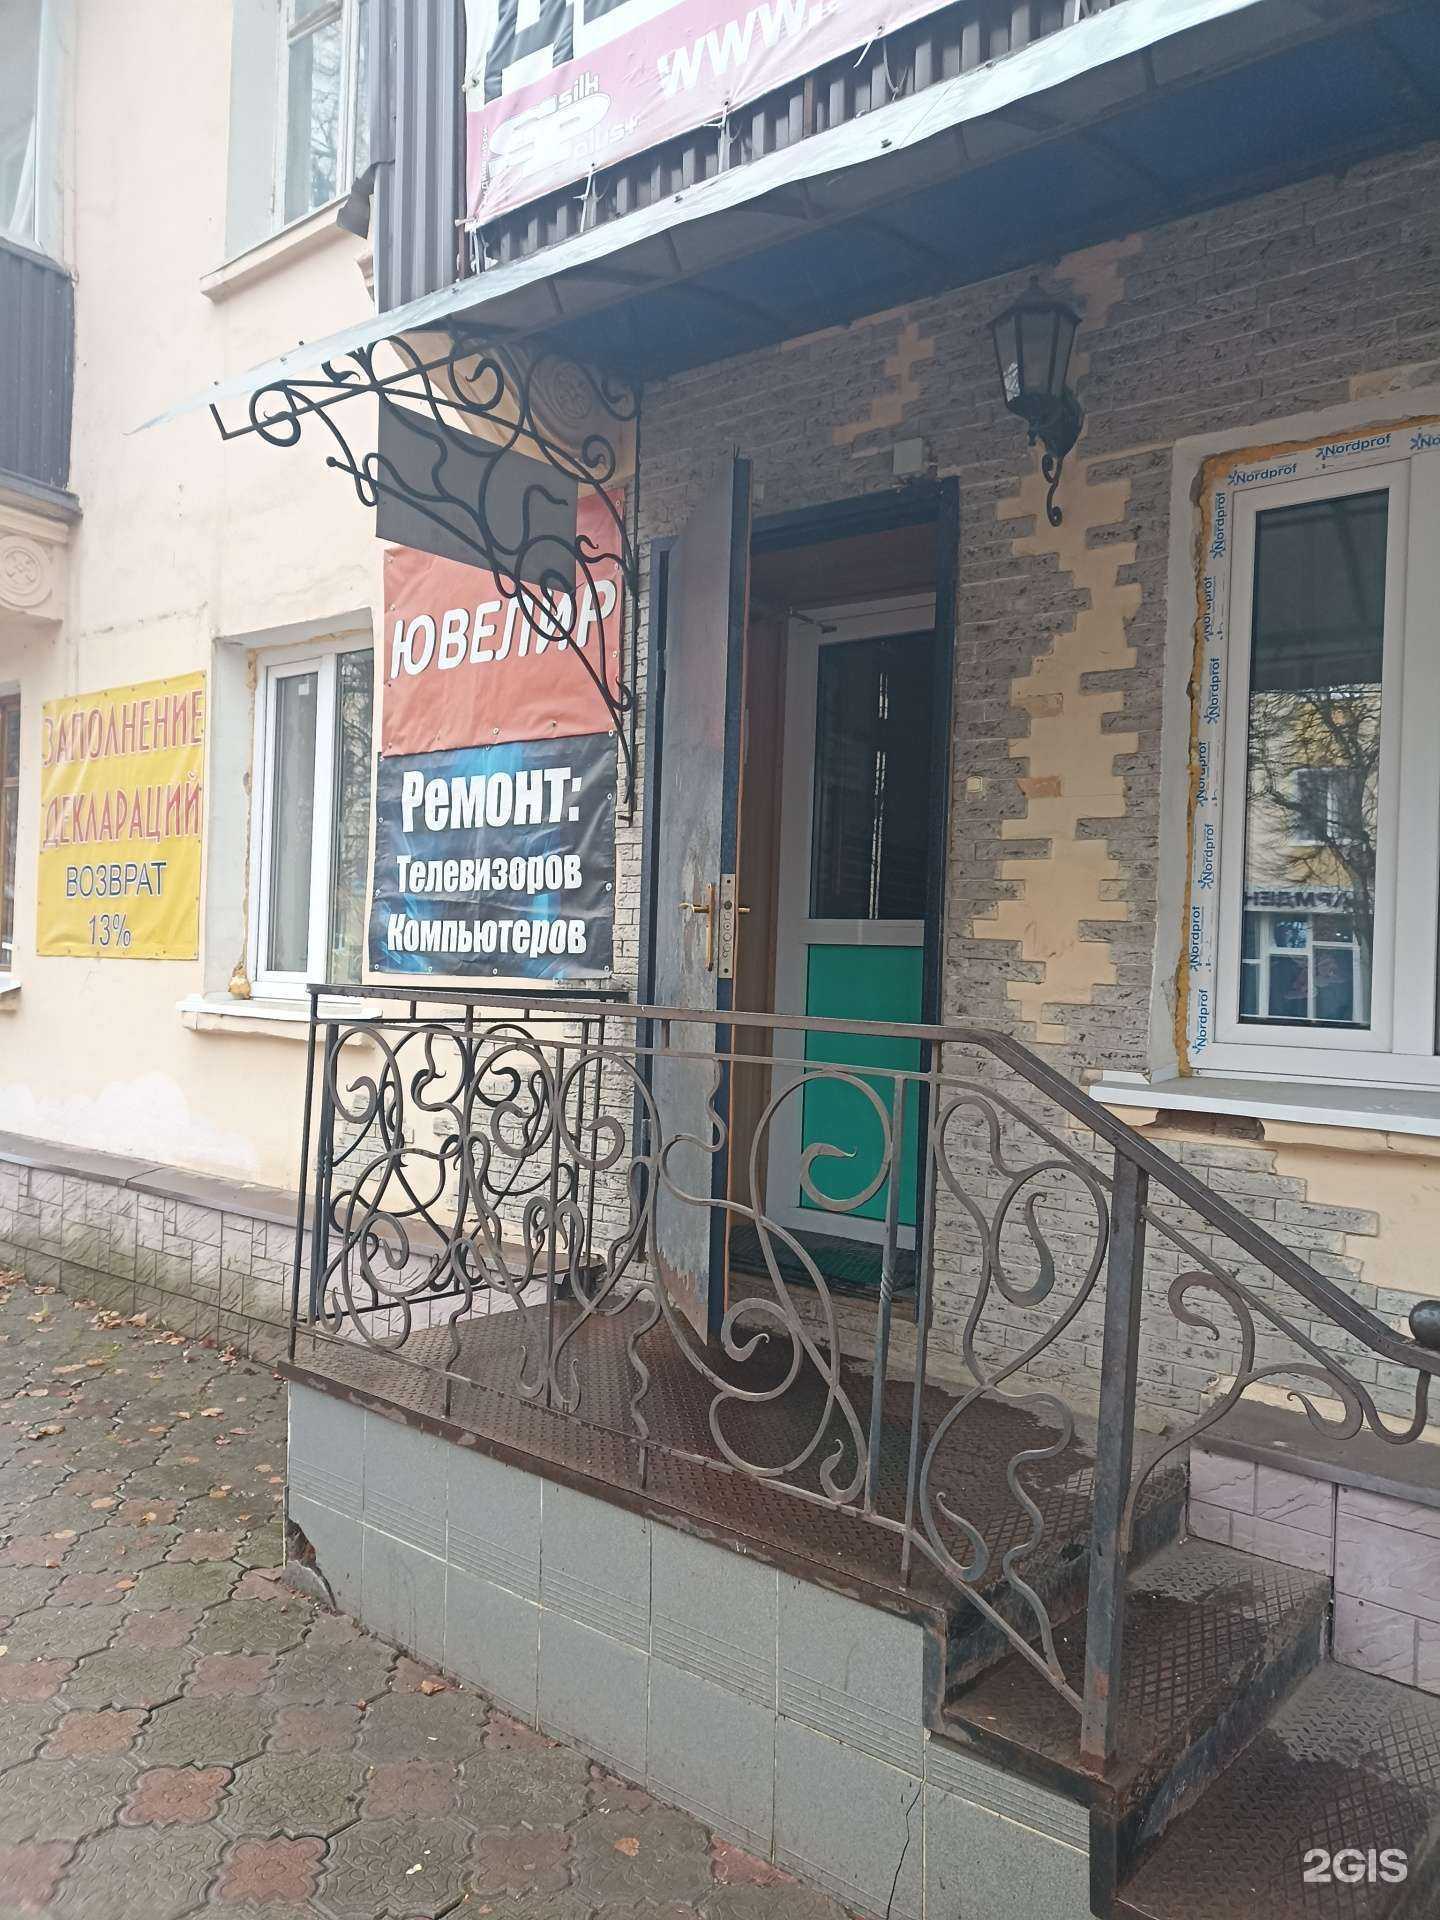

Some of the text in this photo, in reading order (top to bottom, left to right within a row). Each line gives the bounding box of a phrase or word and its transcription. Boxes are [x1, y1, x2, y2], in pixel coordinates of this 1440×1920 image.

[1324, 433, 1392, 457] Nordprof
[1236, 463, 1297, 485] Nordprof
[1216, 492, 1227, 550] Nordprof
[390, 580, 617, 679] ЮВЕЛИР
[1210, 657, 1222, 716] Nordprof
[43, 689, 204, 766] ЗАПОЛНЕНИЕ
[42, 771, 201, 849] ДЕКЛАРАЦИЙ
[402, 767, 582, 832] Ремонт:
[66, 862, 167, 897] ВОЗВРАТ
[397, 854, 582, 894] Телевизоров
[1203, 824, 1216, 880] Nordprof
[89, 914, 132, 947] 13%
[387, 914, 587, 958] Компьютеров
[1191, 906, 1202, 963] Nordprof
[1199, 989, 1210, 1047] Nordprof
